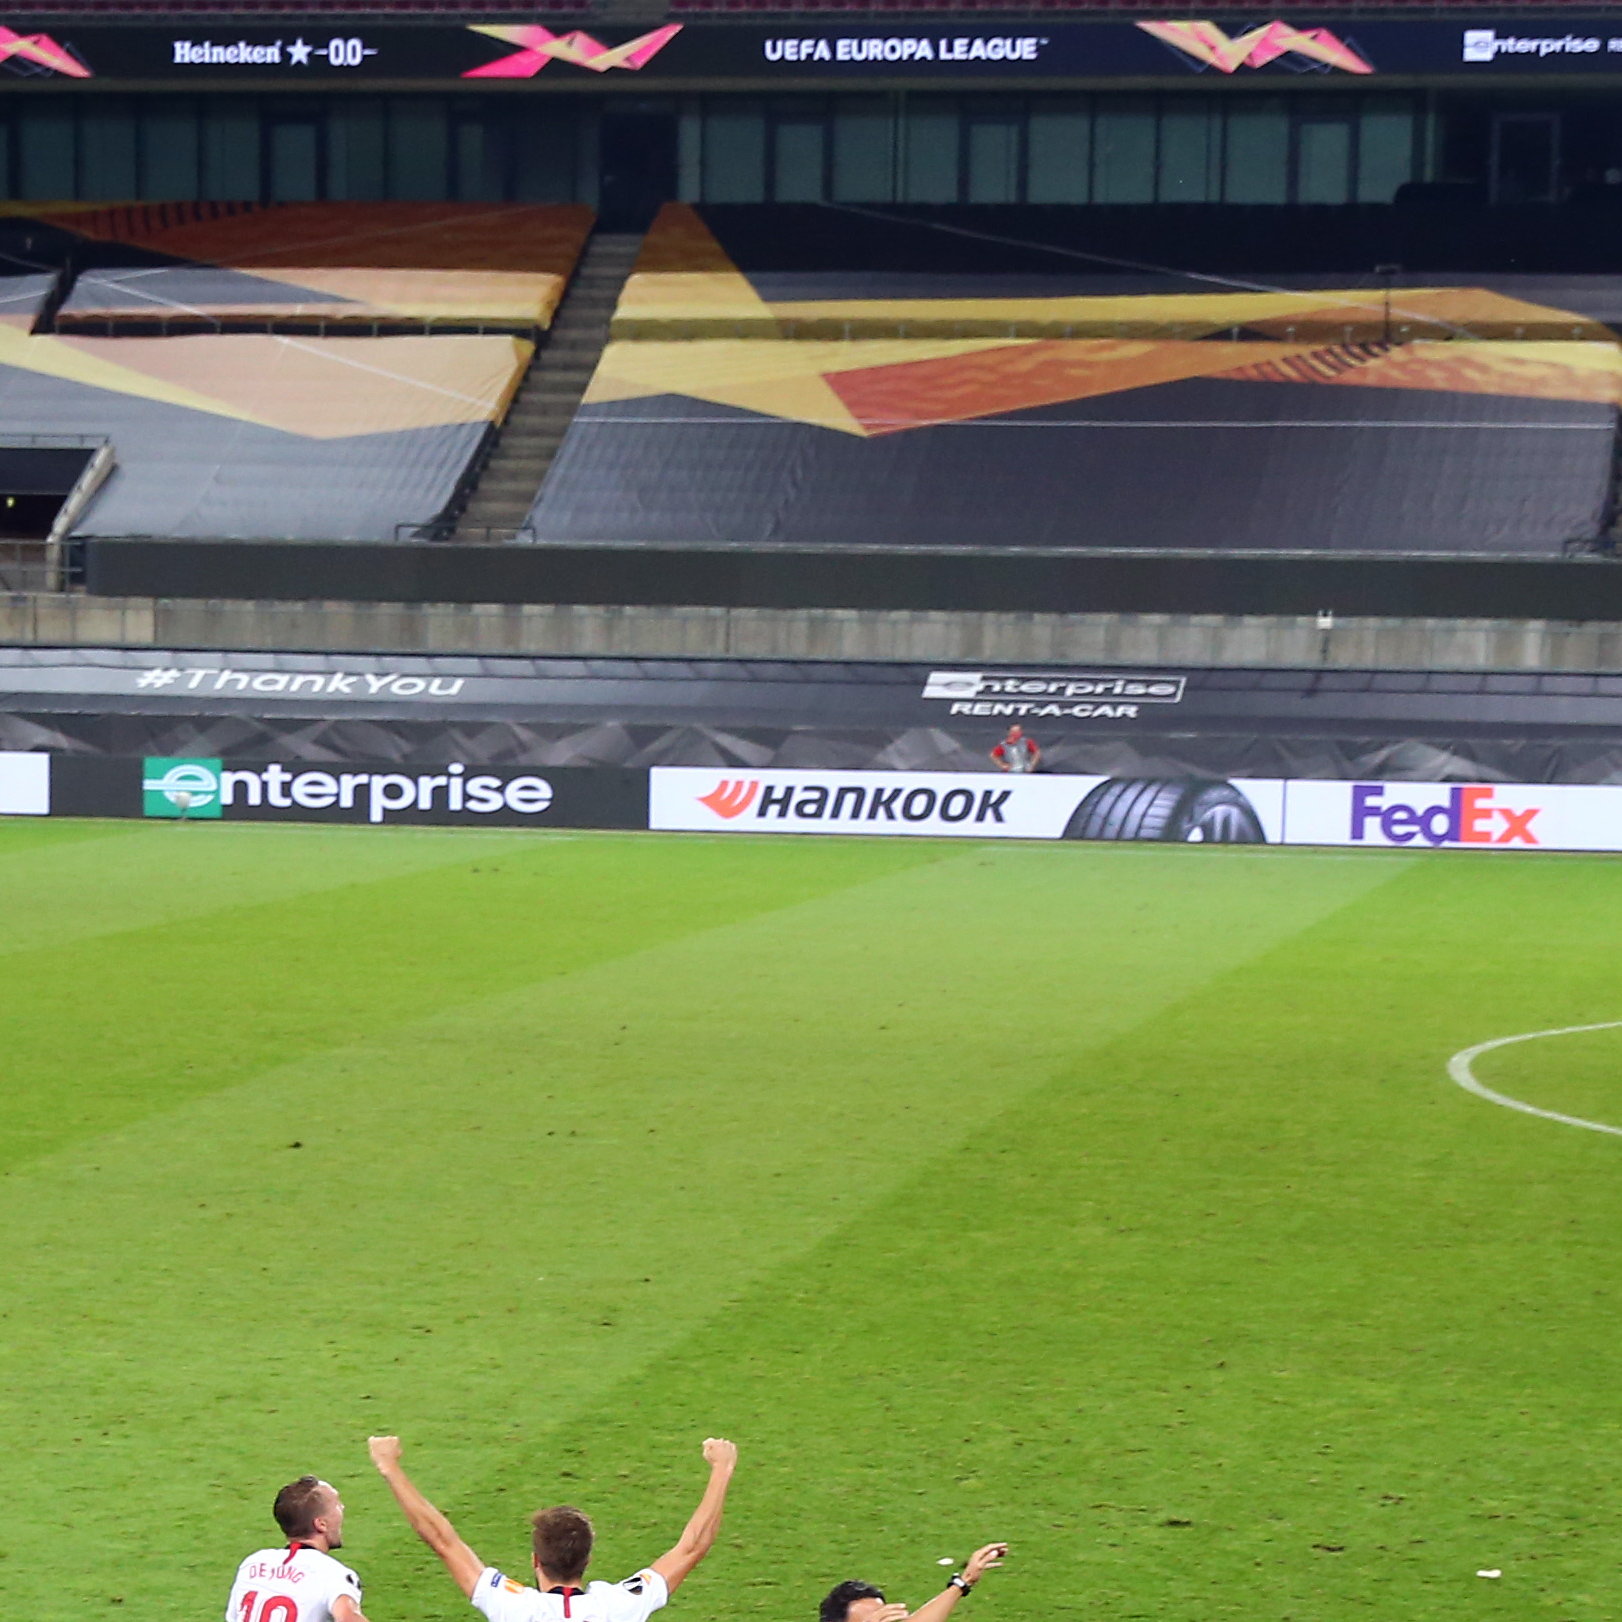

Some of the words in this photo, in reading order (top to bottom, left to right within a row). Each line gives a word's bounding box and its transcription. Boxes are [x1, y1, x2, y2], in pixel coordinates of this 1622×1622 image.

[173, 41, 281, 65] Heineken
[764, 39, 831, 61] UEFA
[836, 38, 933, 61] EUROPA
[938, 37, 1038, 61] LEAGUE
[1463, 29, 1600, 61] enterprise
[135, 667, 465, 698] #ThankYou
[949, 702, 1140, 719] RENT-A-CAR
[142, 762, 554, 822] enterprise
[1350, 784, 1543, 848] FedEx
